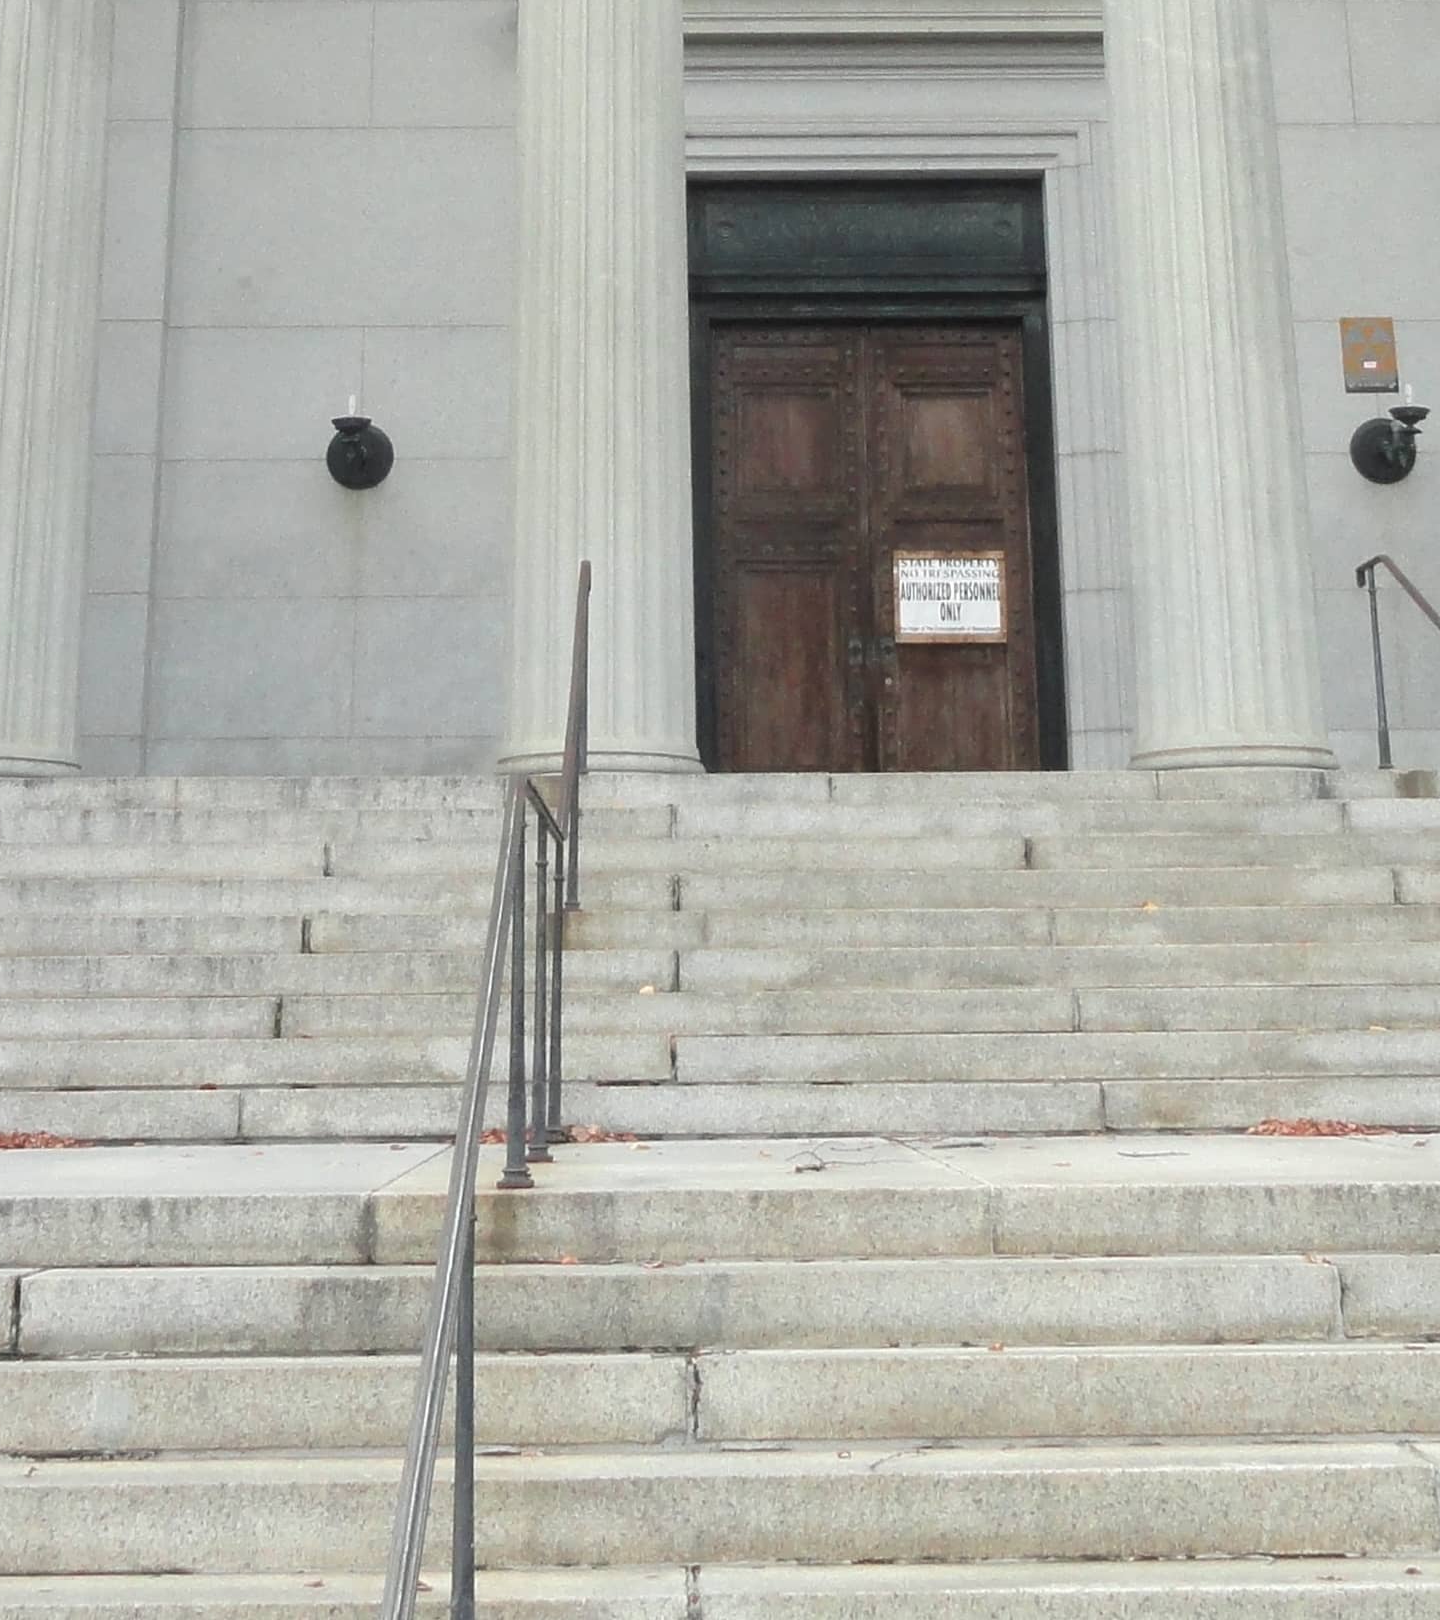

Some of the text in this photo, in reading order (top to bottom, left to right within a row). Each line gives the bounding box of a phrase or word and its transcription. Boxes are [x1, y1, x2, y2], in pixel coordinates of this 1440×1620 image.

[900, 559, 998, 568] STATE PROPERTY
[901, 569, 1000, 578] NO TRESPASSING
[901, 582, 1001, 601] AUTHORIZED PERSONNEL
[940, 602, 961, 621] ONLY
